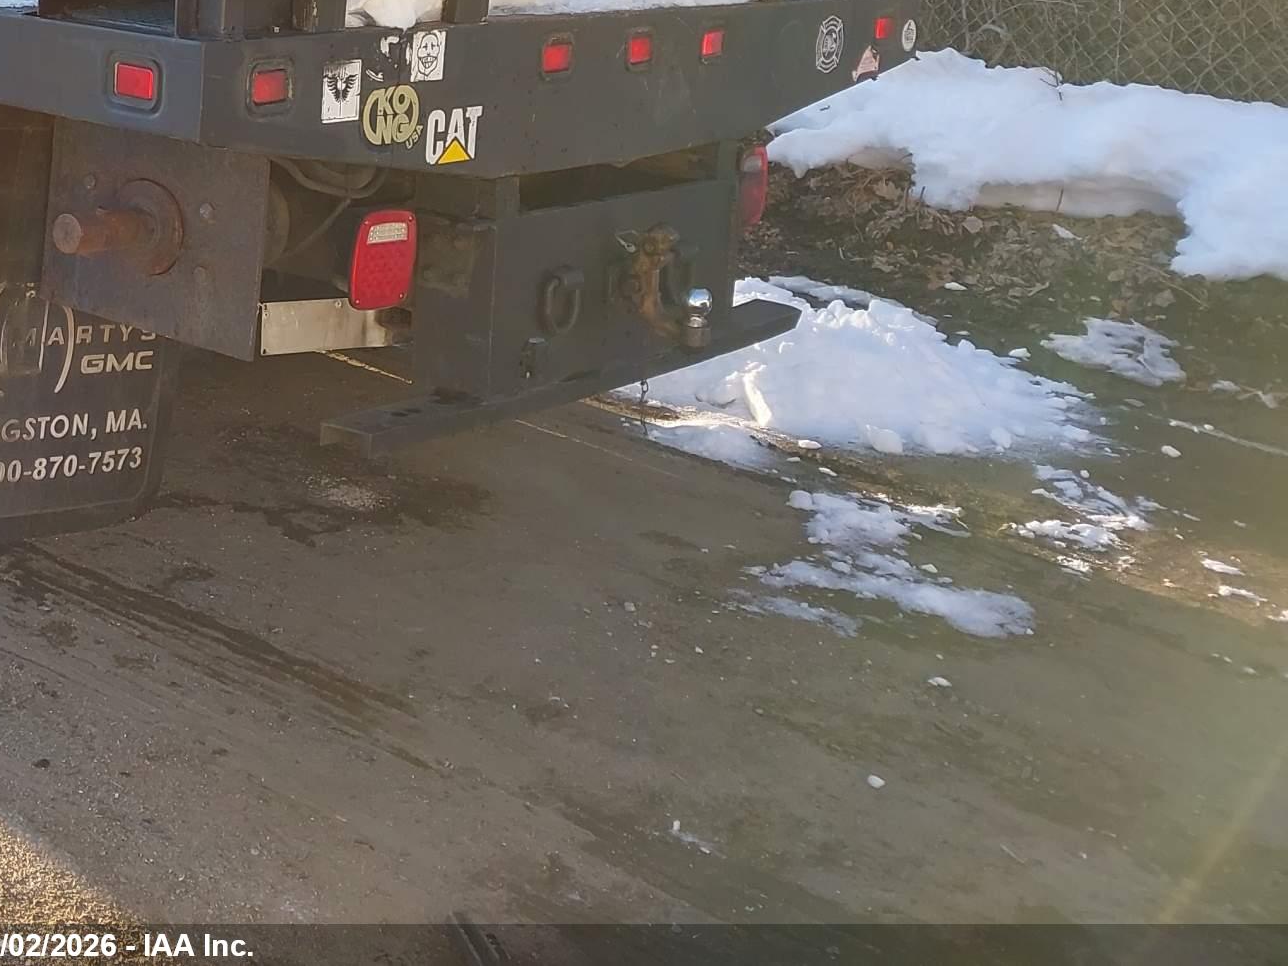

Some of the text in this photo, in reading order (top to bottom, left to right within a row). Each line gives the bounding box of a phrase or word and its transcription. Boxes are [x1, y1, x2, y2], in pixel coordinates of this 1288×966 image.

[405, 125, 424, 150] USA
[425, 106, 483, 165] CAT
[80, 350, 154, 375] GMC
[105, 408, 148, 434] MA.
